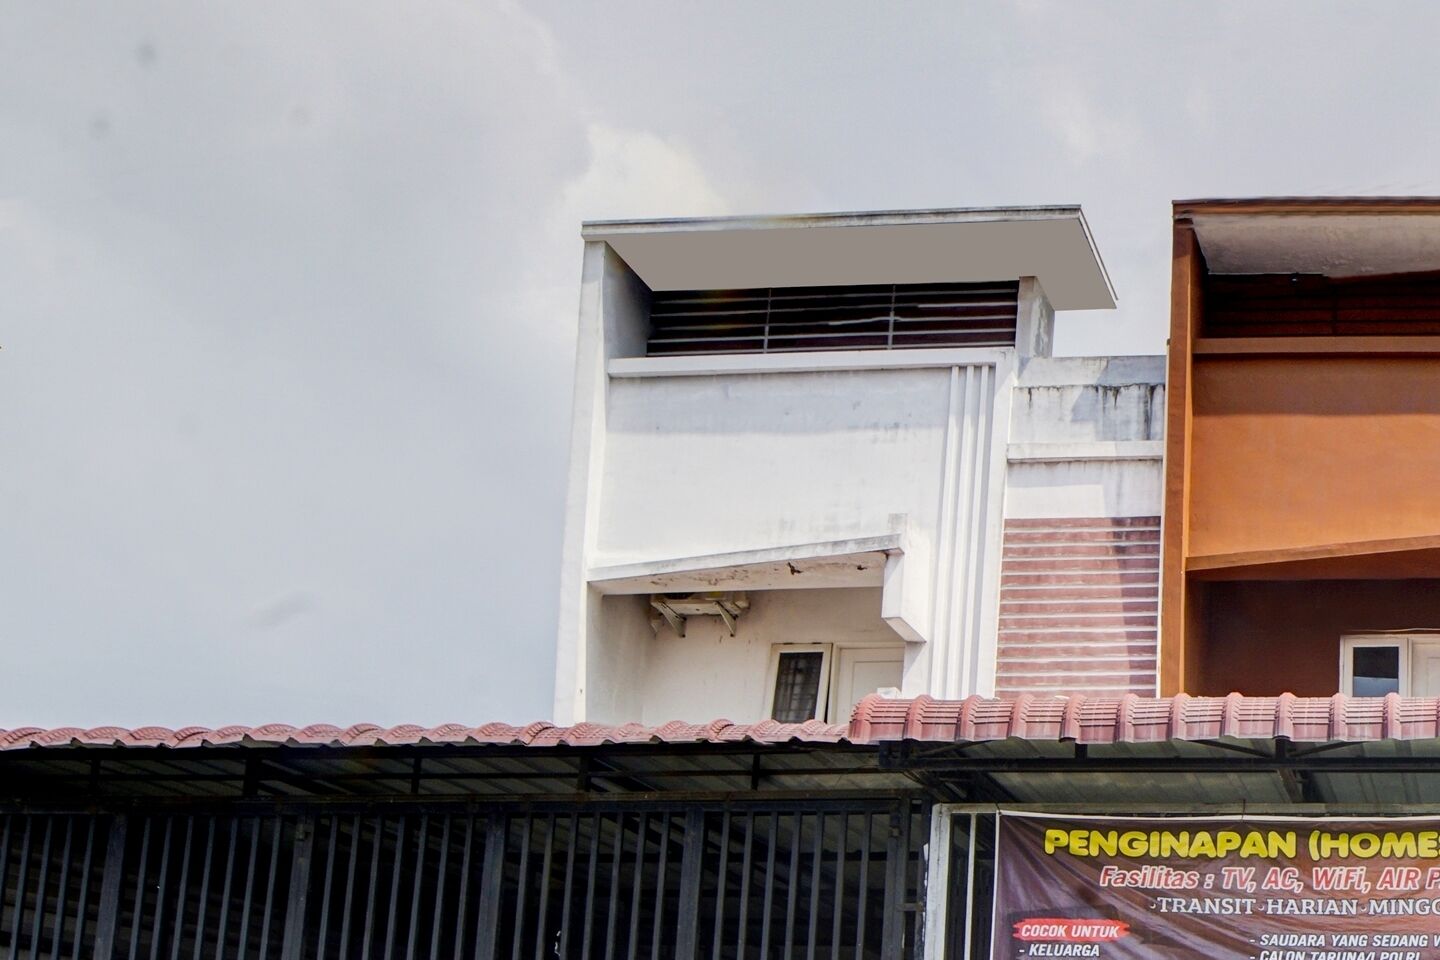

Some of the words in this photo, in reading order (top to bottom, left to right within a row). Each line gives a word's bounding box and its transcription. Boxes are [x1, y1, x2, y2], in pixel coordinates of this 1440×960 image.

[1044, 829, 1297, 858] PENGINAPAN
[1100, 865, 1199, 889] Fasilitas
[1222, 867, 1256, 892] TV,
[1262, 867, 1303, 893] AC,
[1312, 865, 1371, 893] WiFi,
[1376, 867, 1421, 890] AIR
[1157, 897, 1256, 915] TRANSIT
[1266, 898, 1358, 915] HARIAN
[1021, 924, 1066, 937] COCOK
[1071, 925, 1120, 938] UNTUK
[1259, 934, 1326, 947] SAUDARA
[1331, 934, 1368, 947] YANG
[1372, 934, 1428, 947] SEDANG
[1029, 944, 1100, 957] KELUARGA
